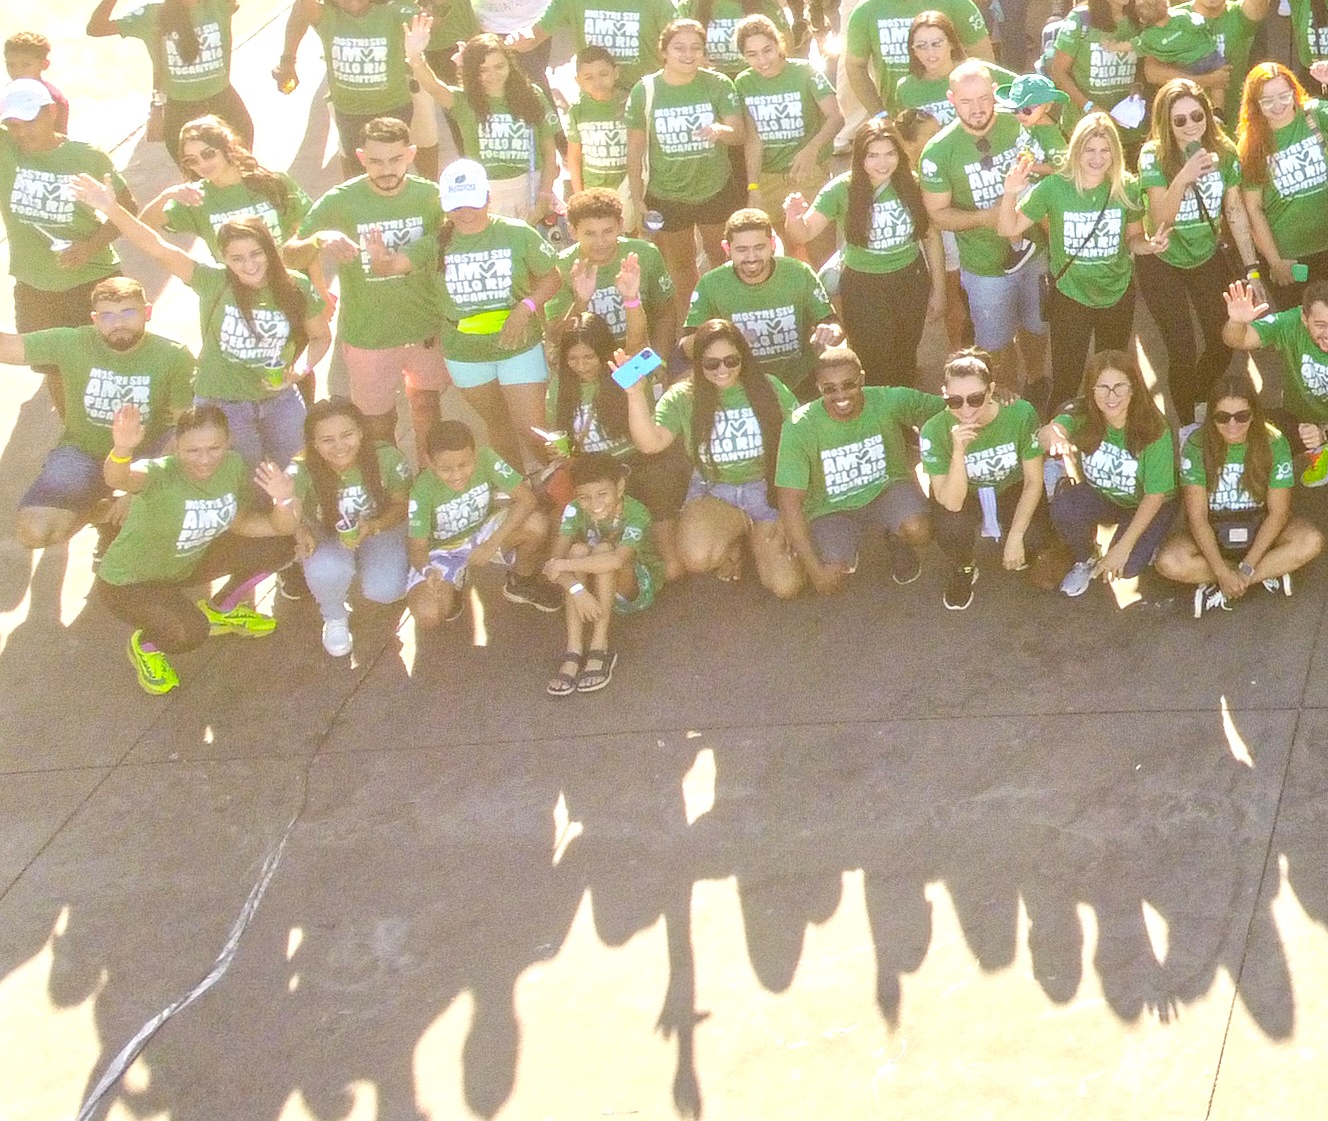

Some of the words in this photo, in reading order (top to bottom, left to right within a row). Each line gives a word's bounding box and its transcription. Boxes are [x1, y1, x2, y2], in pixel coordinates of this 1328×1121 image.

[1274, 169, 1305, 191] PELO
[446, 280, 482, 295] PELO
[825, 468, 858, 486] PELO
